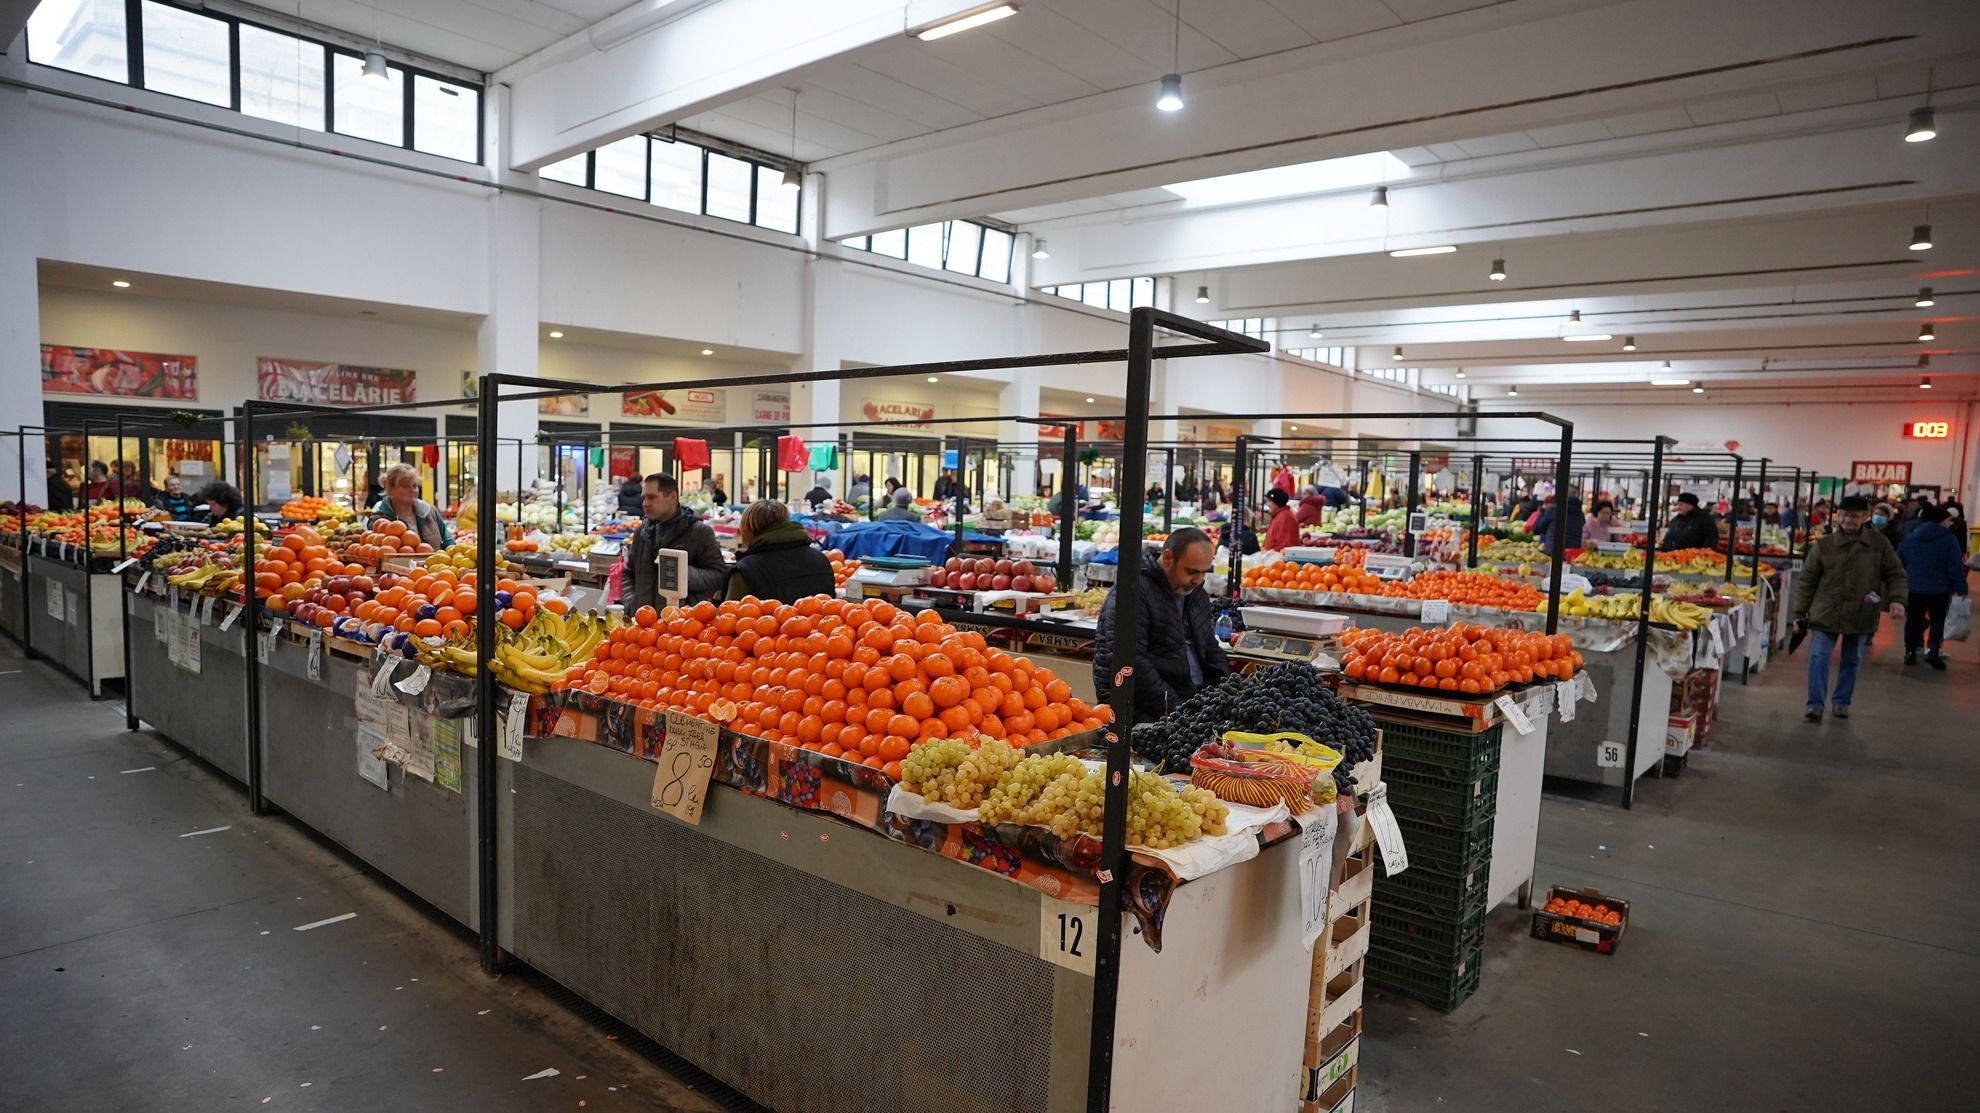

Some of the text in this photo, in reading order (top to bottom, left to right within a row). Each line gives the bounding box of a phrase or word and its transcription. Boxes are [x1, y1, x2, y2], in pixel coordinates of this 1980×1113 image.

[1855, 463, 1907, 480] BAZAR
[1038, 633, 1079, 648] SAMBA
[1604, 746, 1618, 762] 56
[662, 752, 692, 807] 8
[1058, 913, 1083, 957] 12
